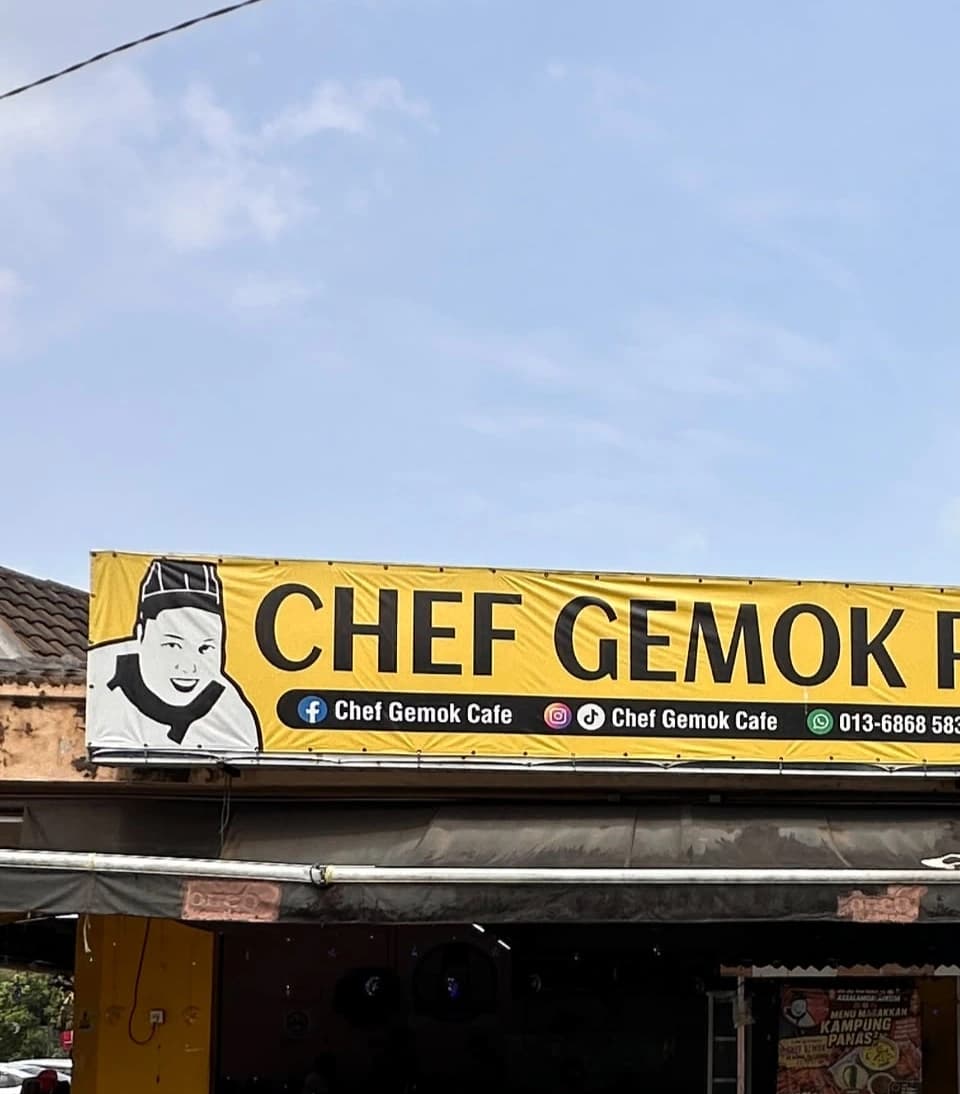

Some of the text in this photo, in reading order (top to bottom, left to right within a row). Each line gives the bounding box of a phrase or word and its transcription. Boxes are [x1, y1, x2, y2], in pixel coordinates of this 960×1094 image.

[254, 583, 523, 676] CHEF
[553, 596, 907, 689] GEMOK
[335, 700, 513, 724] Chef Gemok Cafe
[612, 707, 778, 731] Chef Gemok Cafe
[839, 713, 926, 734] 013-6868
[820, 1017, 892, 1034] KAMPUNG
